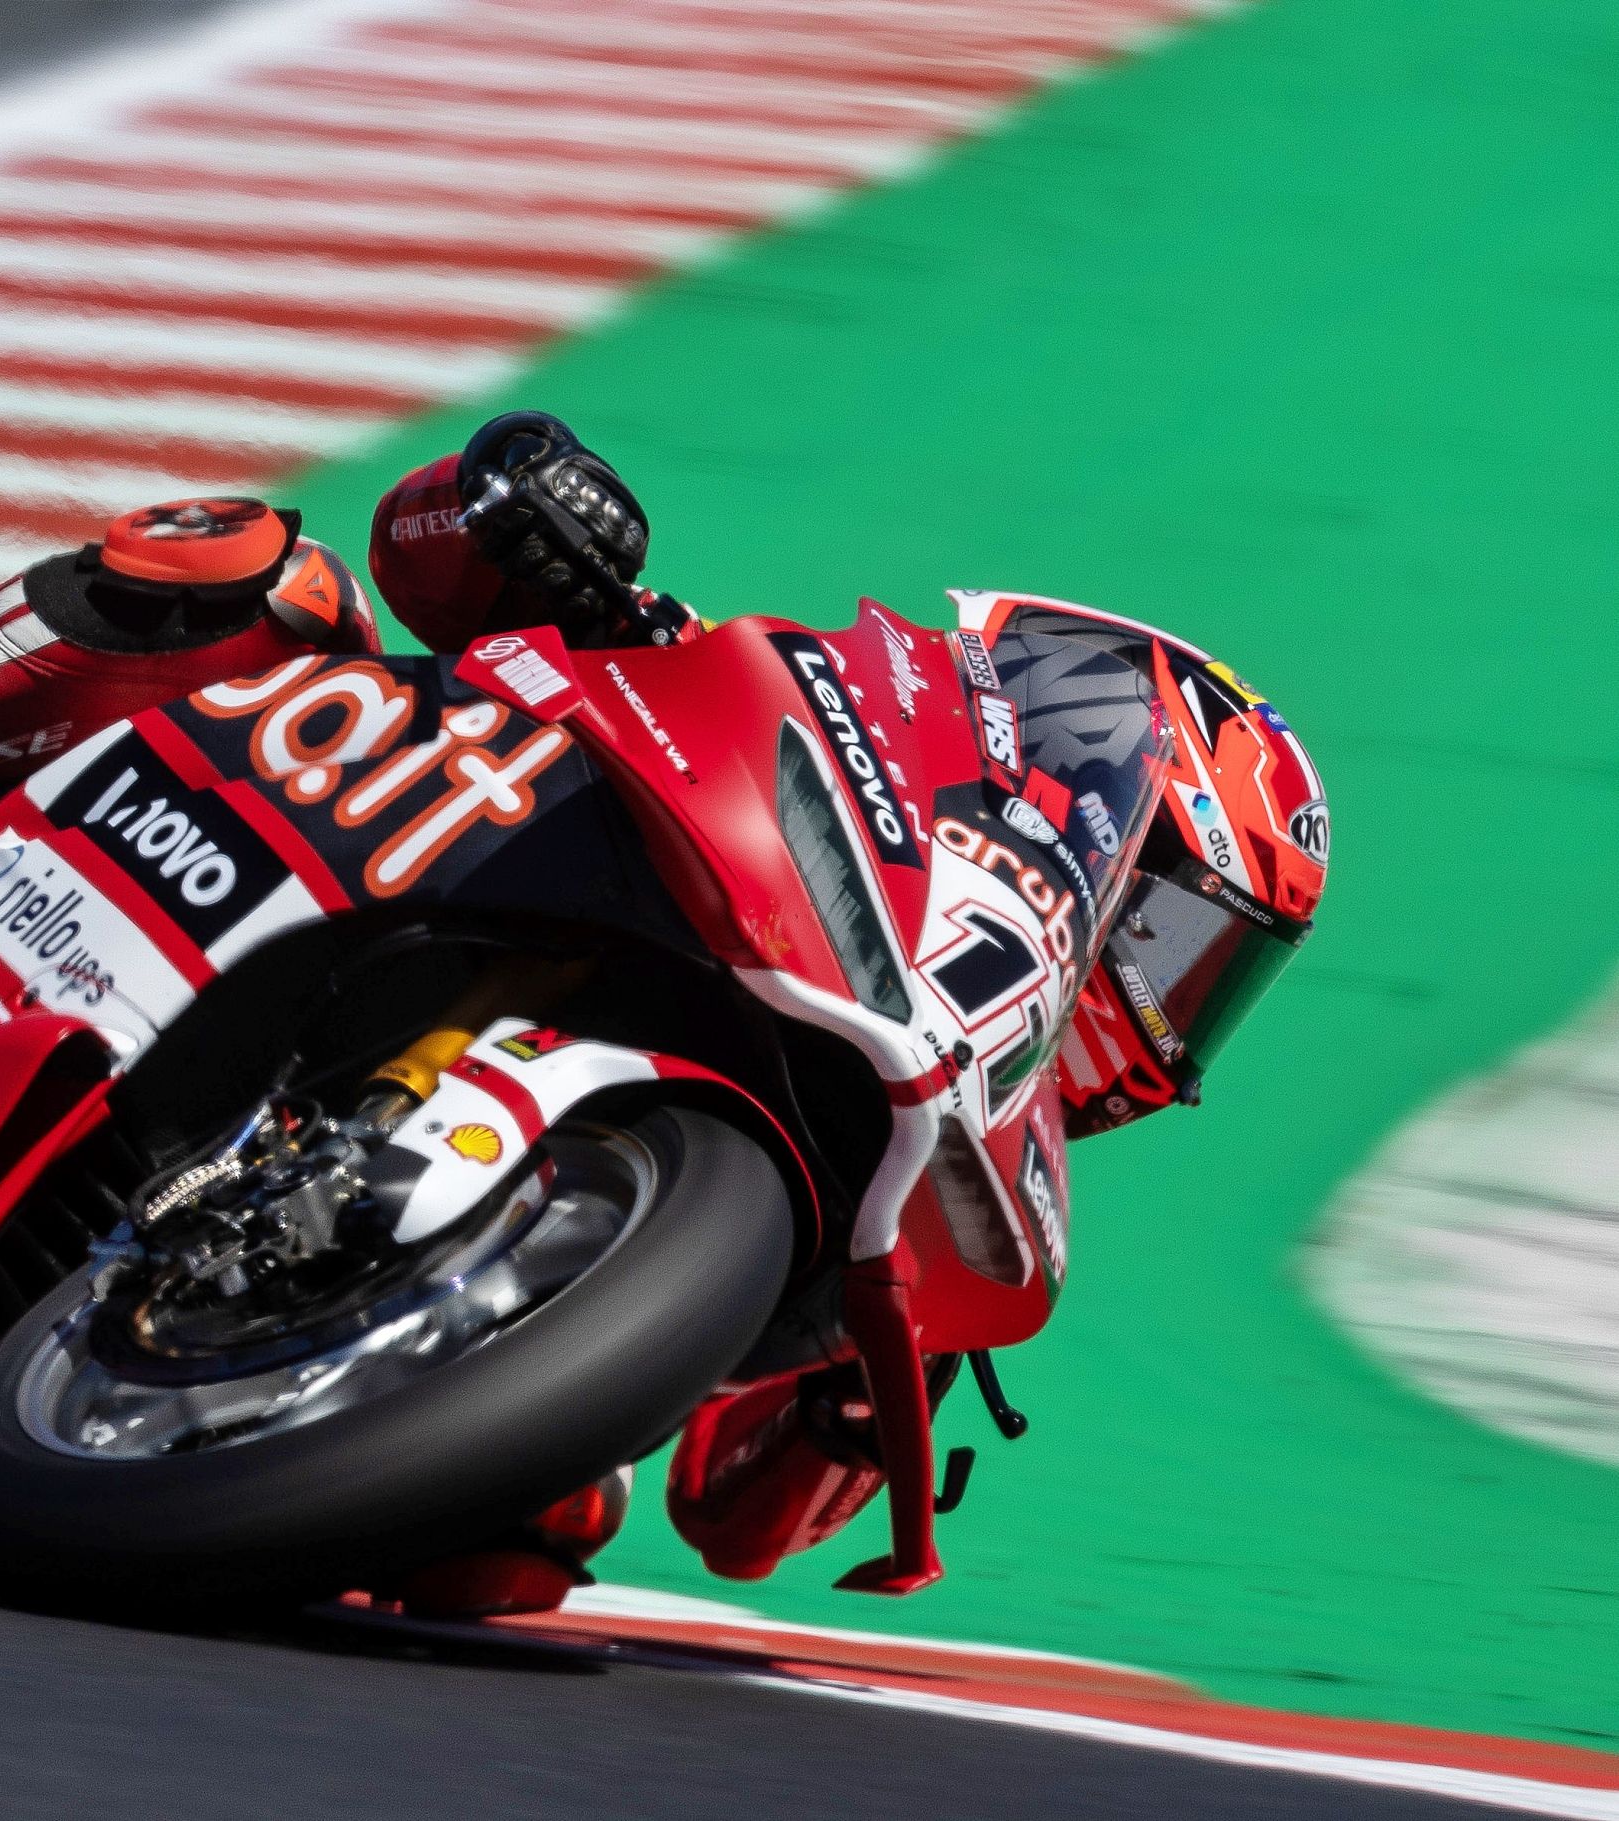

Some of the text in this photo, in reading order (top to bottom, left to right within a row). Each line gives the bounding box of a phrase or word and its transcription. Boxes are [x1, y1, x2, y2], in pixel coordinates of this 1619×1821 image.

[605, 661, 671, 747] PANIGALE
[822, 639, 931, 843] ALTEN
[979, 694, 1019, 771] WRS
[793, 649, 905, 847] Lenovo
[83, 767, 238, 905] Lnovo
[1219, 887, 1274, 926] PASCUCCI
[57, 945, 115, 1007] ups
[923, 1030, 963, 1109] DUCATI
